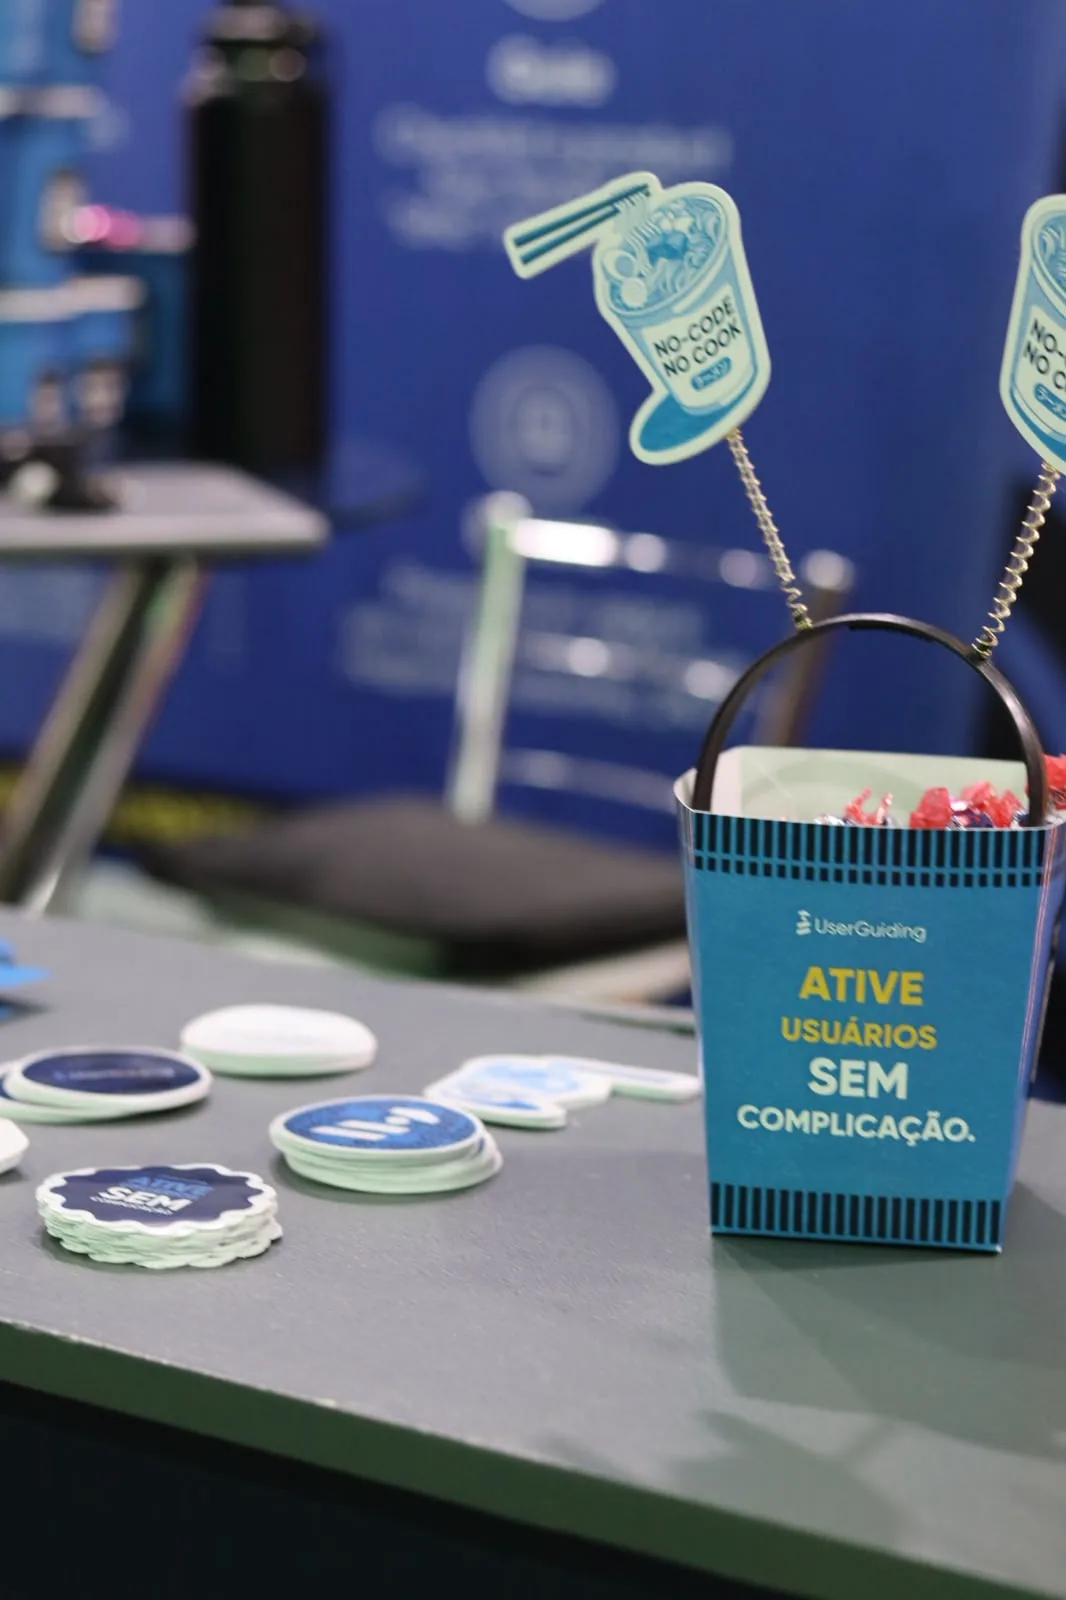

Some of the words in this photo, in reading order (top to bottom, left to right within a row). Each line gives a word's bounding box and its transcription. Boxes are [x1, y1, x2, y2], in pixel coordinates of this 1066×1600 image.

[653, 296, 734, 357] NO-CODE
[662, 355, 690, 377] NO
[693, 318, 742, 364] COOK
[1022, 340, 1050, 375] NO
[814, 918, 927, 943] UserGuiding
[798, 965, 925, 1006] ATIVE
[781, 1015, 937, 1050] USUÁRIOS
[808, 1056, 909, 1100] SEM
[736, 1104, 976, 1146] COMPLICAÇÃO.
[98, 1186, 193, 1212] SEM
